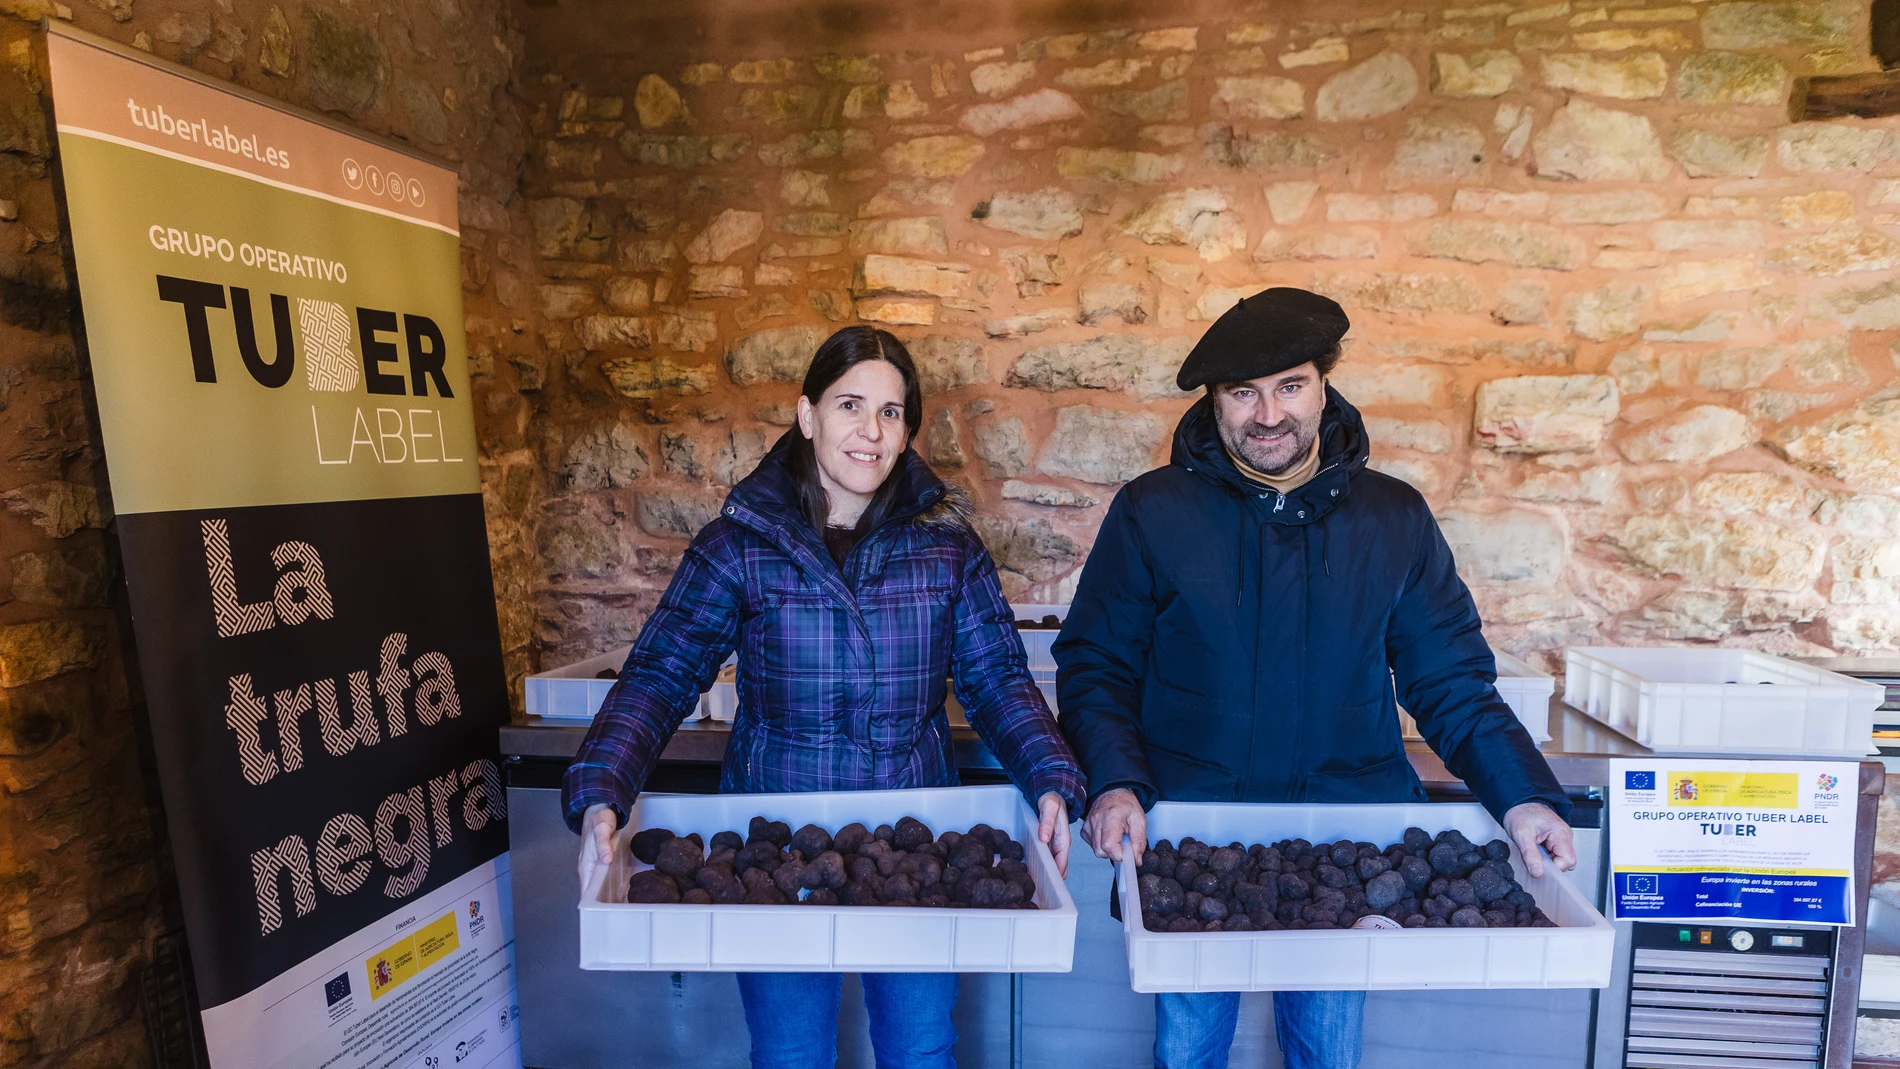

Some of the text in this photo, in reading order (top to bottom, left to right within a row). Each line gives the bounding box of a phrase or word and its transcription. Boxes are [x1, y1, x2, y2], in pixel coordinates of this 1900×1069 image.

[127, 97, 291, 170] tuberlabel.es
[148, 224, 348, 284] GRUPO OPERATIVO
[155, 274, 455, 399] TUBER
[311, 405, 464, 465] LABEL
[200, 518, 334, 638] La
[225, 632, 462, 786] trufa
[1633, 811, 1829, 824] GRUPO OPERATIVO TUBER LABEL
[1700, 823, 1757, 837] TUBER
[250, 758, 507, 937] negra
[1771, 868, 1797, 876] Europea
[1701, 876, 1724, 885] Europa
[1725, 876, 1750, 884] invierte
[1639, 894, 1664, 902] Europea
[395, 916, 416, 931] FINANCIA
[469, 915, 485, 929] PNDR
[394, 950, 412, 965] GOBIERNO
